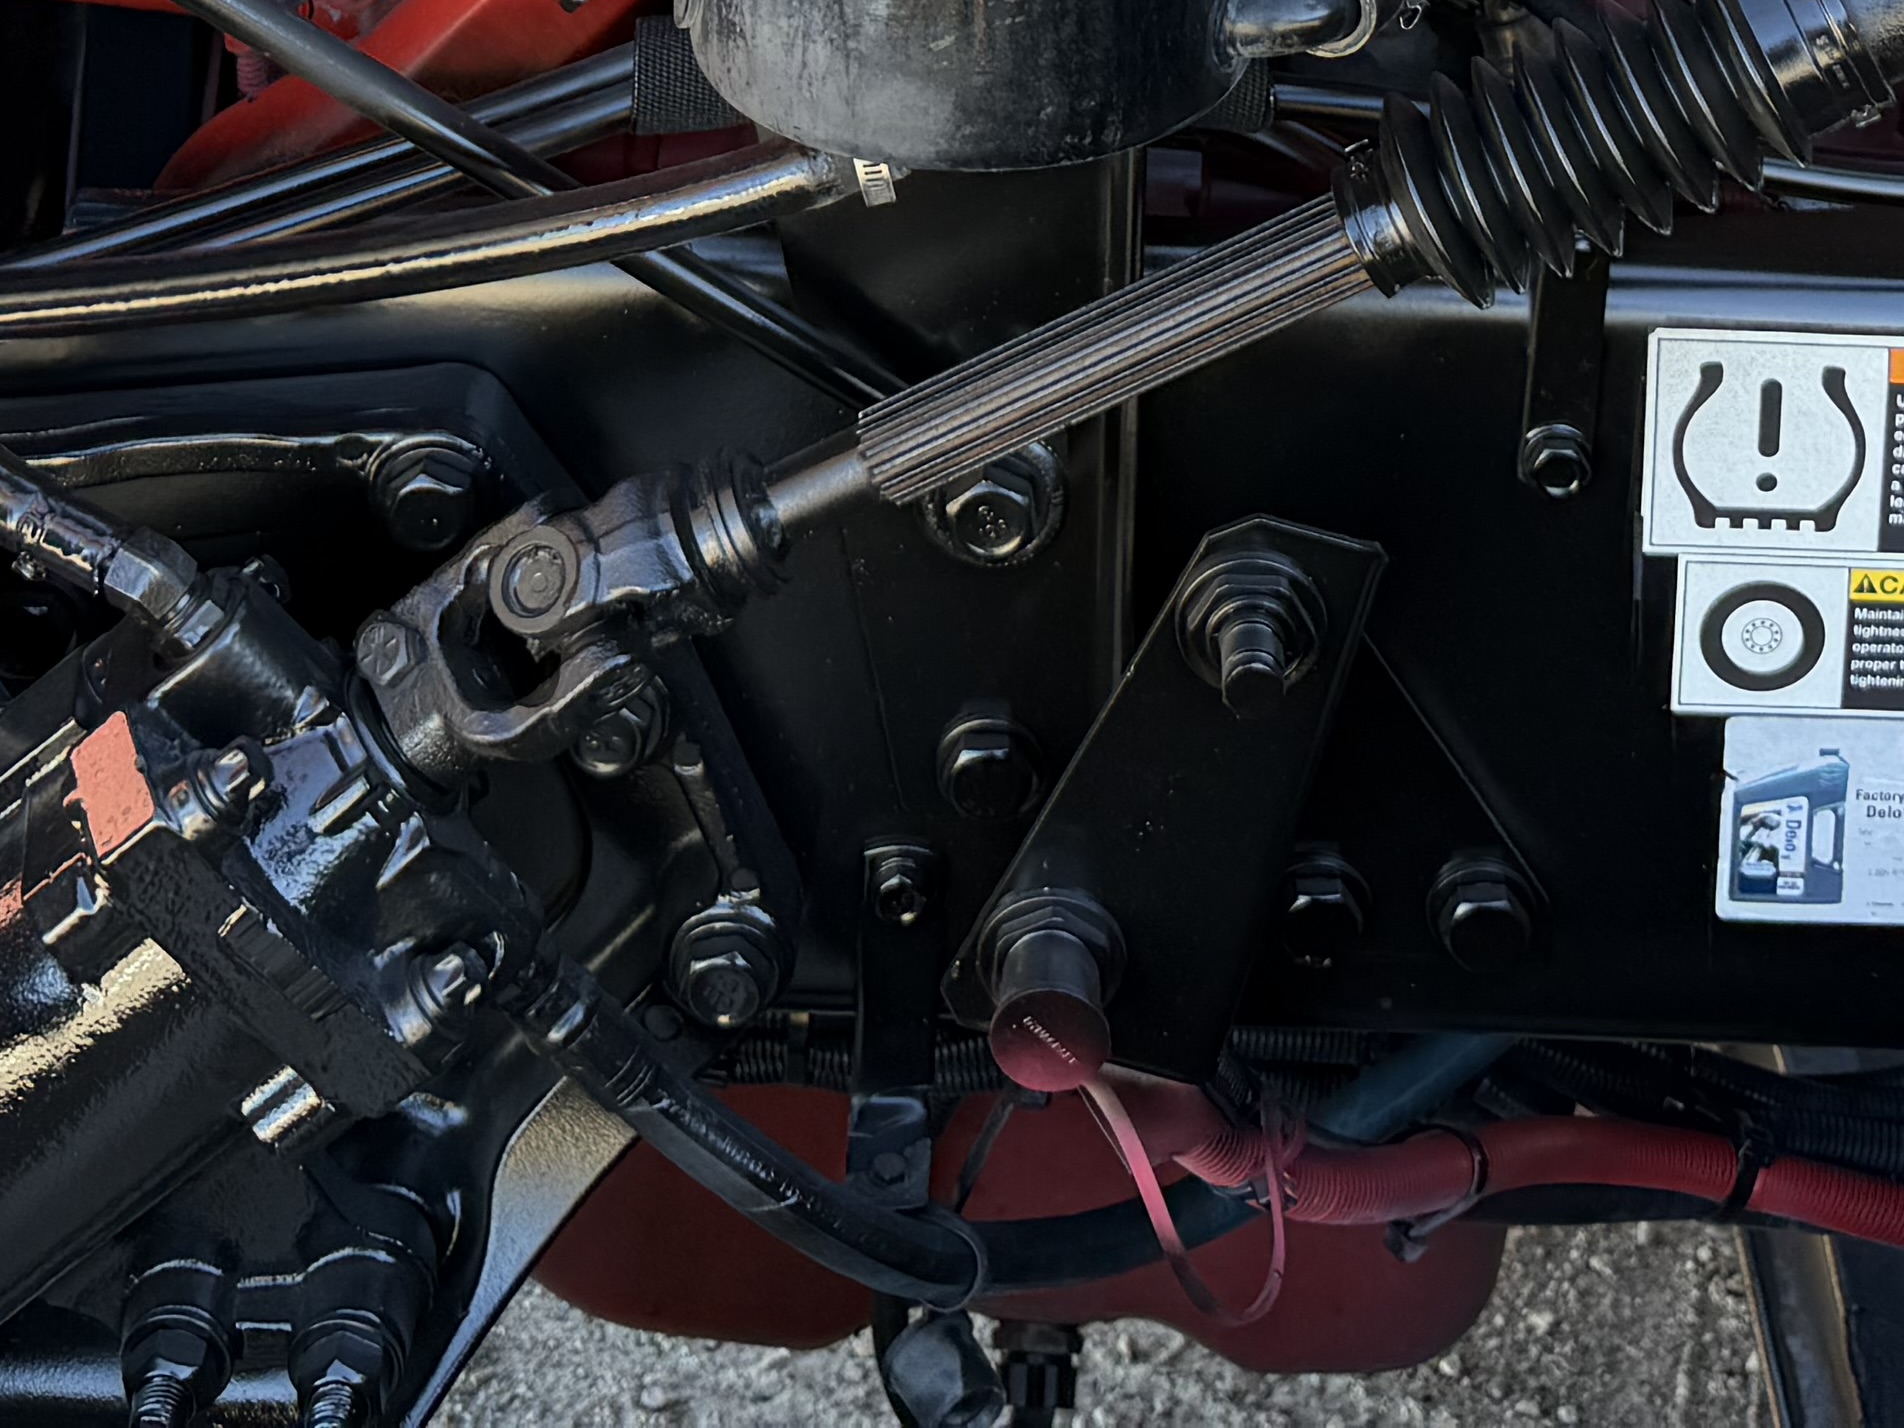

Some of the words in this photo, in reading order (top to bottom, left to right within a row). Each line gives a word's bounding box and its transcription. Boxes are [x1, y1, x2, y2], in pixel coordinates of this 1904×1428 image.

[1891, 480, 1901, 491] a
[1851, 659, 1896, 672] proper
[1856, 789, 1904, 804] Factory
